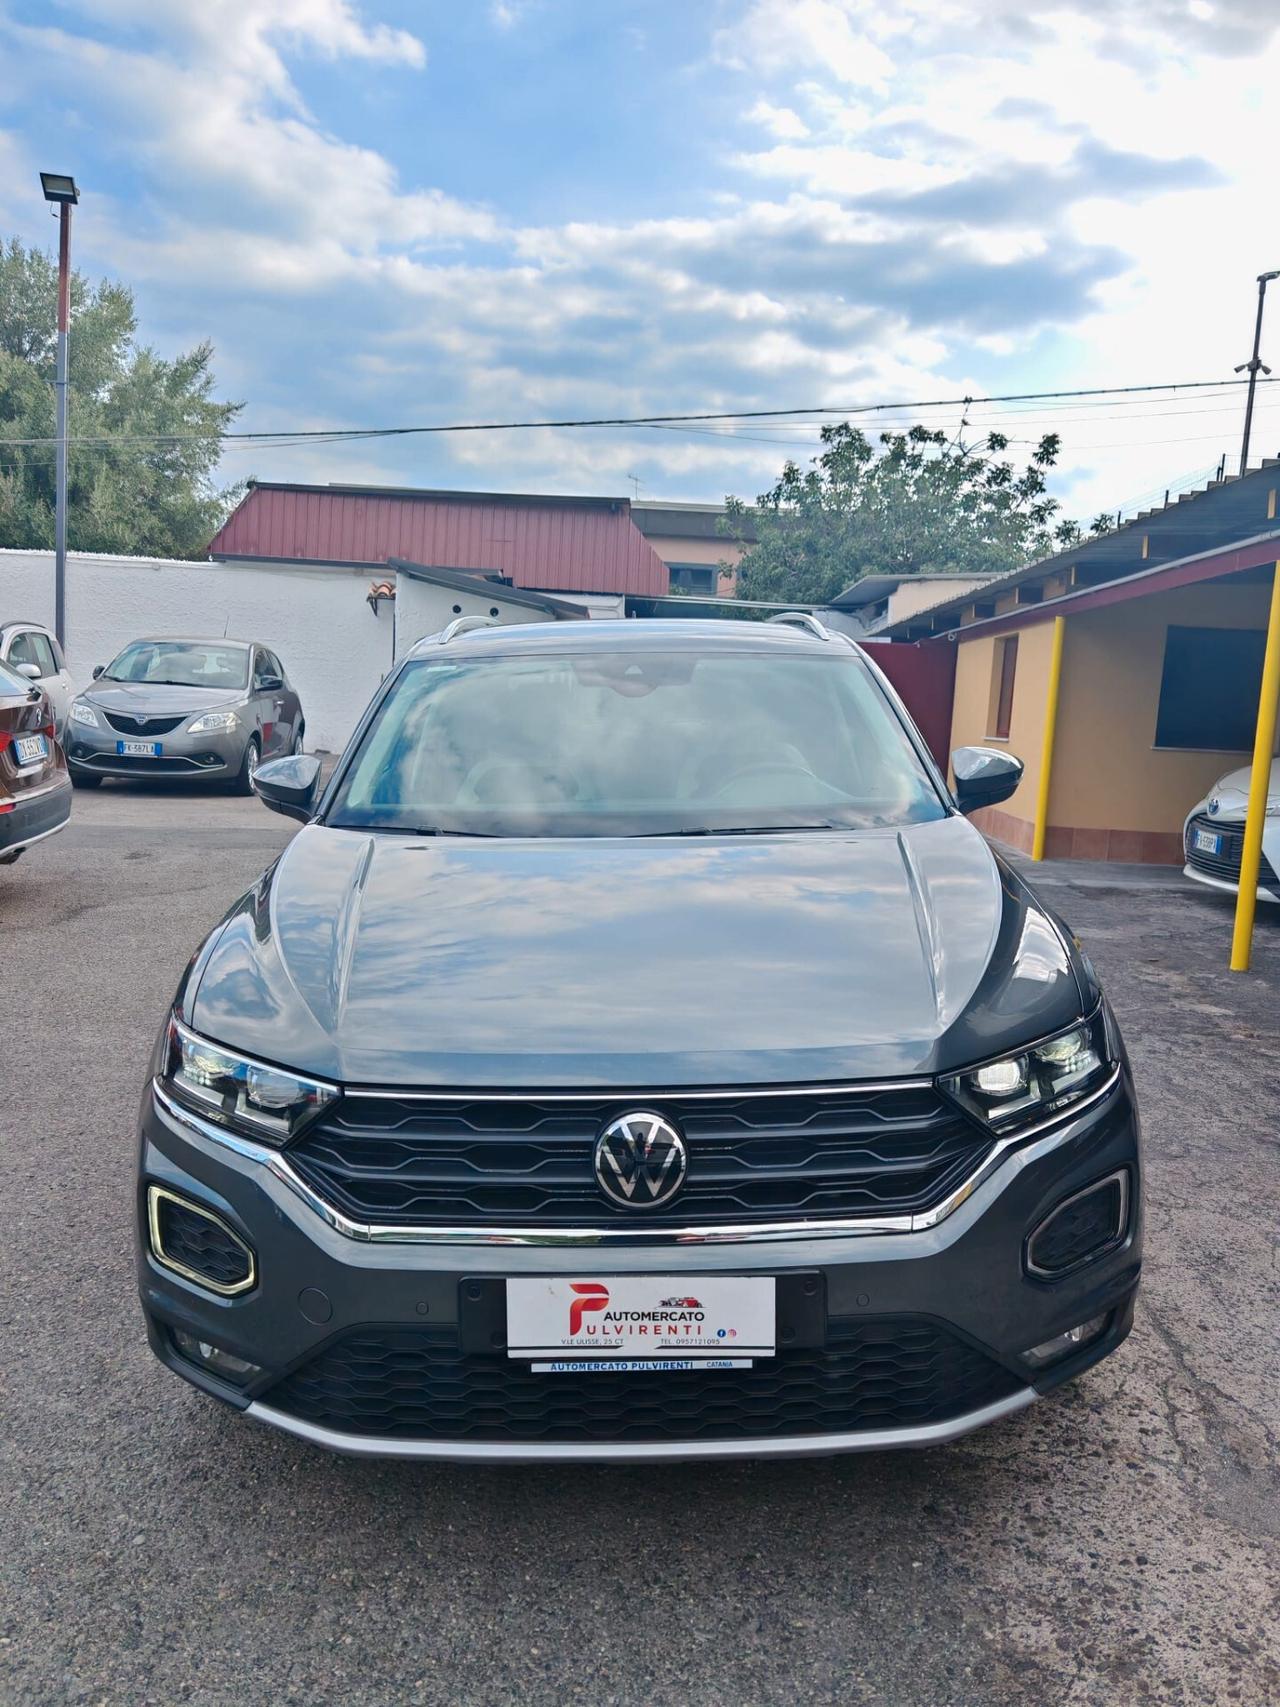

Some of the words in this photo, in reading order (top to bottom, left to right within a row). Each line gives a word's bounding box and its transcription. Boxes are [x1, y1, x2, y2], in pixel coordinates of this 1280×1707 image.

[604, 1311, 705, 1322] AUTOMERCATO
[550, 1361, 629, 1371] AUTOMERCATO
[632, 1361, 693, 1370] PULVIRENTI
